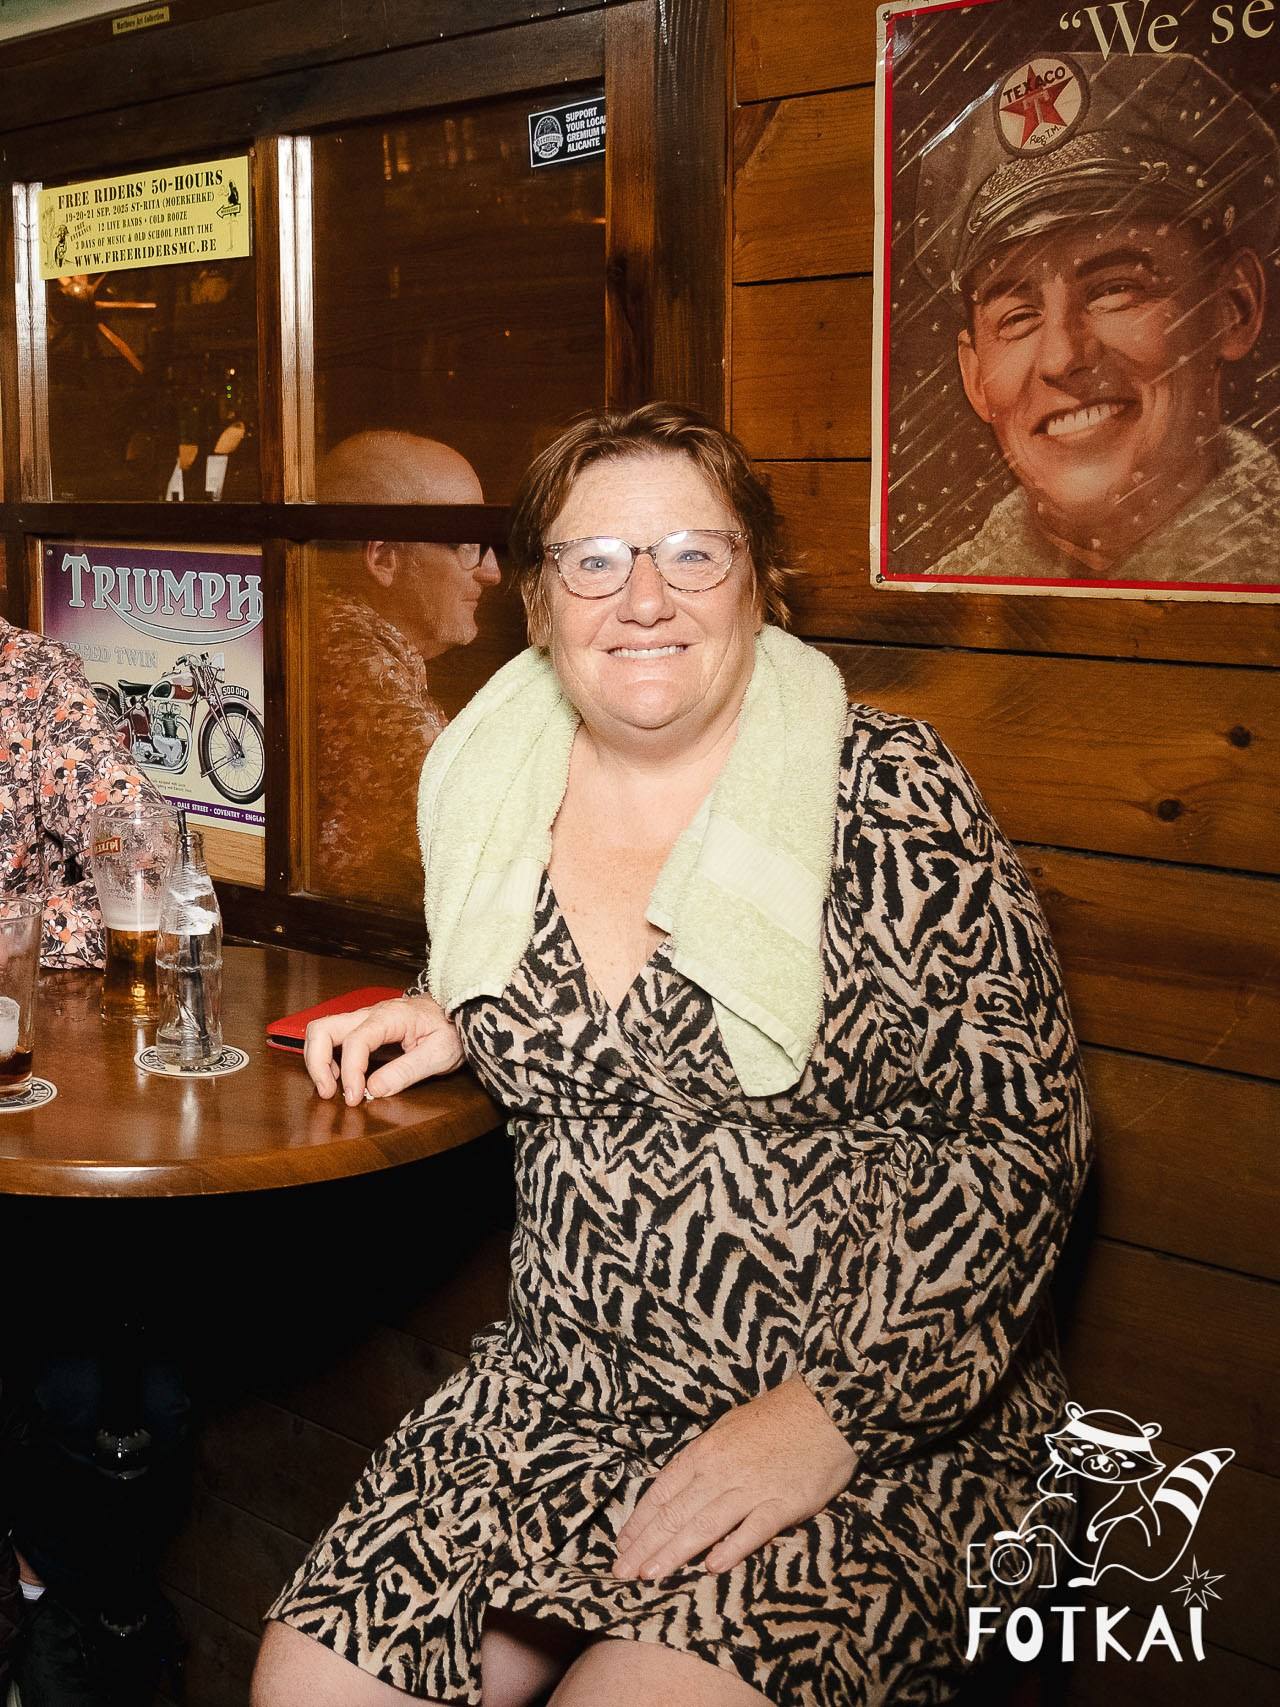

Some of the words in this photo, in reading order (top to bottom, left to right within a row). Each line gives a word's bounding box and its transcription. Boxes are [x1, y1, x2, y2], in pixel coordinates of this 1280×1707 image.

[1003, 66, 1066, 103] TEXACO
[565, 106, 598, 123] SUPPORT
[566, 120, 586, 132] YOUR
[586, 114, 606, 127] LOCA
[566, 126, 600, 143] GREMIUM
[567, 137, 600, 153] ALICANTE
[58, 190, 90, 210] FREE
[94, 181, 146, 204] RIDERS'
[151, 169, 224, 195] 50-HOURS
[65, 210, 94, 223] 19-20-21
[96, 206, 111, 218] SEP.
[113, 202, 129, 215] 2025
[130, 197, 161, 212] ST-RITA
[162, 191, 215, 209] (MOERKERKE)
[98, 222, 105, 232] 12
[106, 219, 120, 231] LIVE
[122, 215, 143, 228] BANDS
[149, 211, 165, 225] COLD
[167, 207, 188, 221] BOOZE
[75, 240, 79, 250] 3
[80, 238, 96, 249] DAYS
[97, 237, 105, 247] OF
[107, 233, 126, 246] MUSIC
[134, 230, 146, 242] OLD
[147, 225, 172, 240] SCHOOL
[174, 222, 195, 236] PARTY
[197, 219, 214, 233] TIME
[74, 237, 218, 268] WWW.FREERIDERSMC.BE
[61, 553, 263, 622] TRIUMPH
[63, 642, 112, 663] PEED
[114, 647, 159, 669] TWIN
[177, 801, 190, 810] DALE
[192, 803, 209, 813] STREET
[213, 808, 240, 819] COVENTRY
